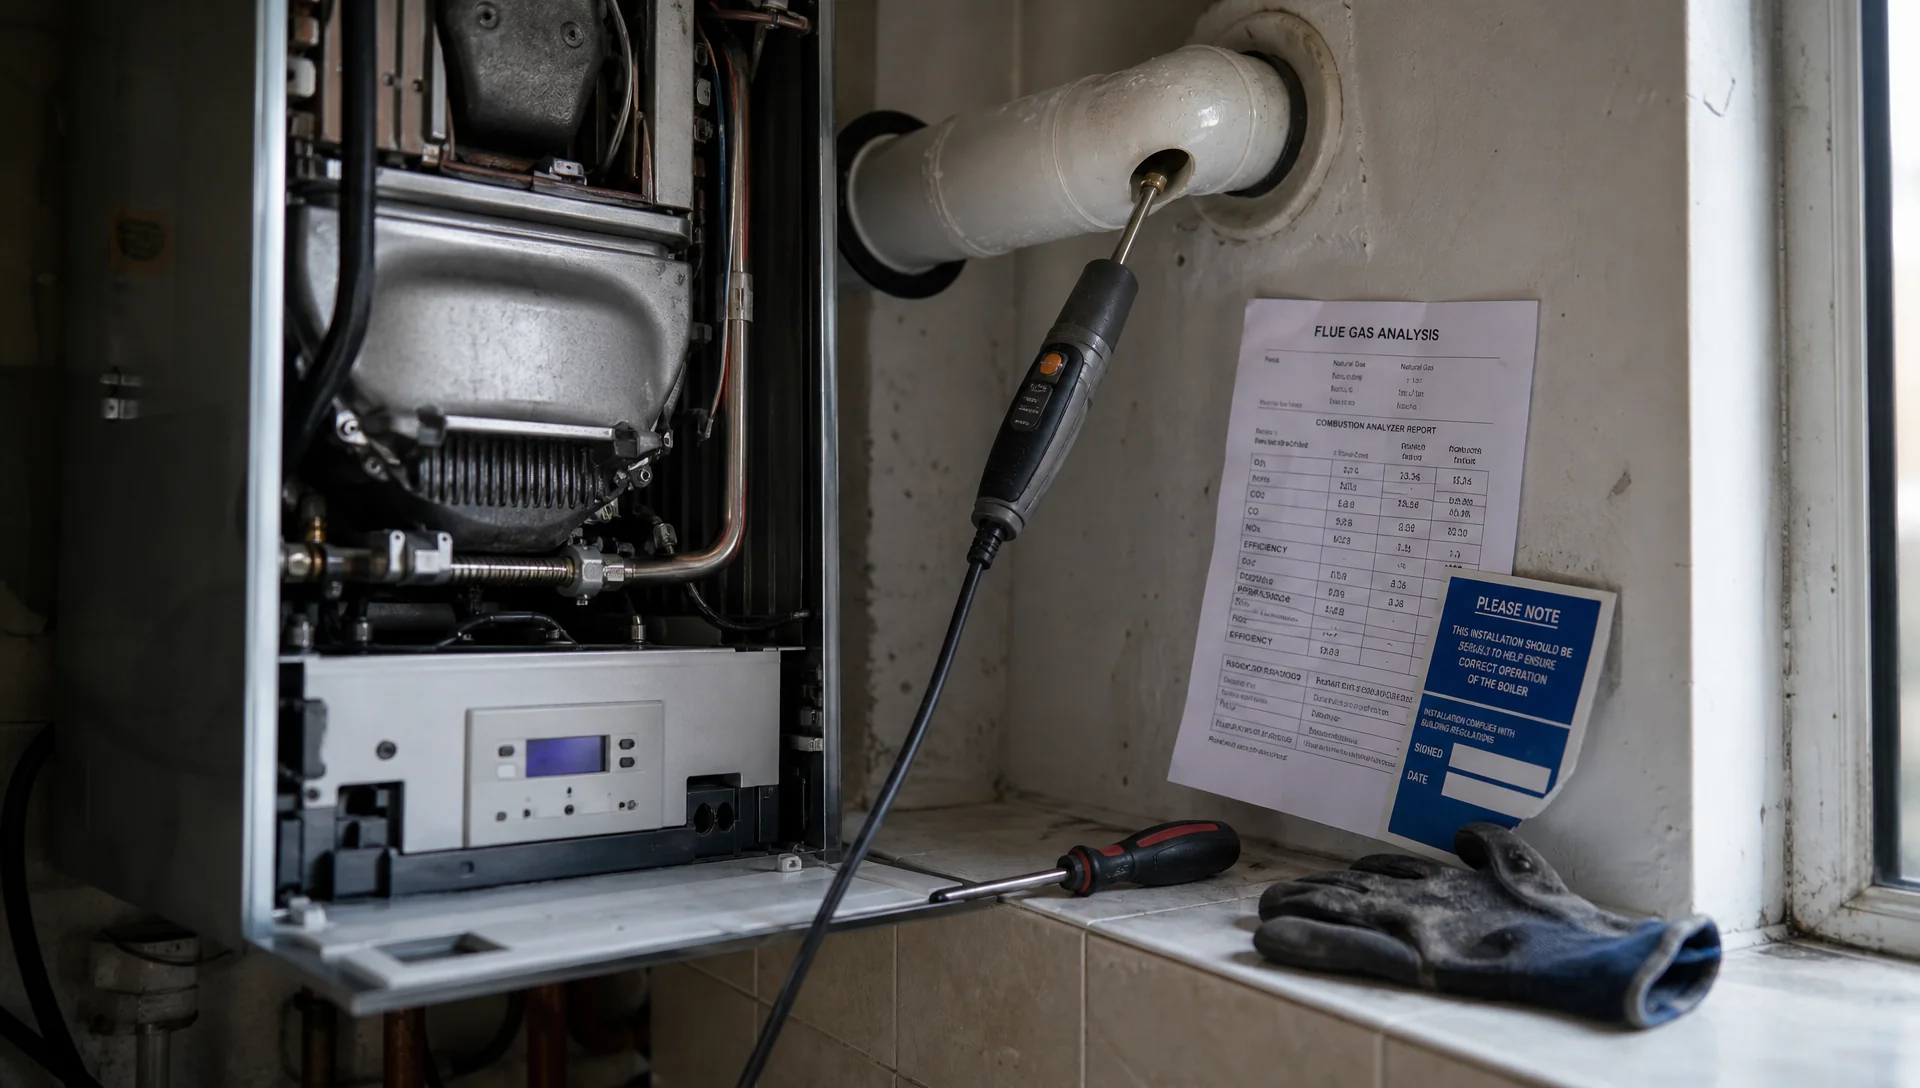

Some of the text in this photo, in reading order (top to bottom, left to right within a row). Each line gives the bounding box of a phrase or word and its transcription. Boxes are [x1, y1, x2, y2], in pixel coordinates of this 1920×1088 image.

[1314, 325, 1439, 341] FLUE GAS ANALYSIS
[1316, 418, 1366, 430] COMBUSTION
[1366, 422, 1405, 433] ANALYZER
[1247, 506, 1259, 516] CO
[1243, 540, 1288, 553] EFFICIENCY
[1476, 595, 1561, 624] PLEASE NOTE
[1452, 624, 1574, 659] THIS INSTALLATION SHOULD BE
[1491, 647, 1502, 659] TO
[1502, 650, 1524, 662] HELP
[1523, 654, 1557, 671] ENSURE
[1458, 656, 1548, 685] CORRECT OPERATION
[1467, 673, 1529, 697] OF THE BOILER
[1423, 707, 1466, 725] INSTALLATION
[1407, 769, 1429, 785] DATE
